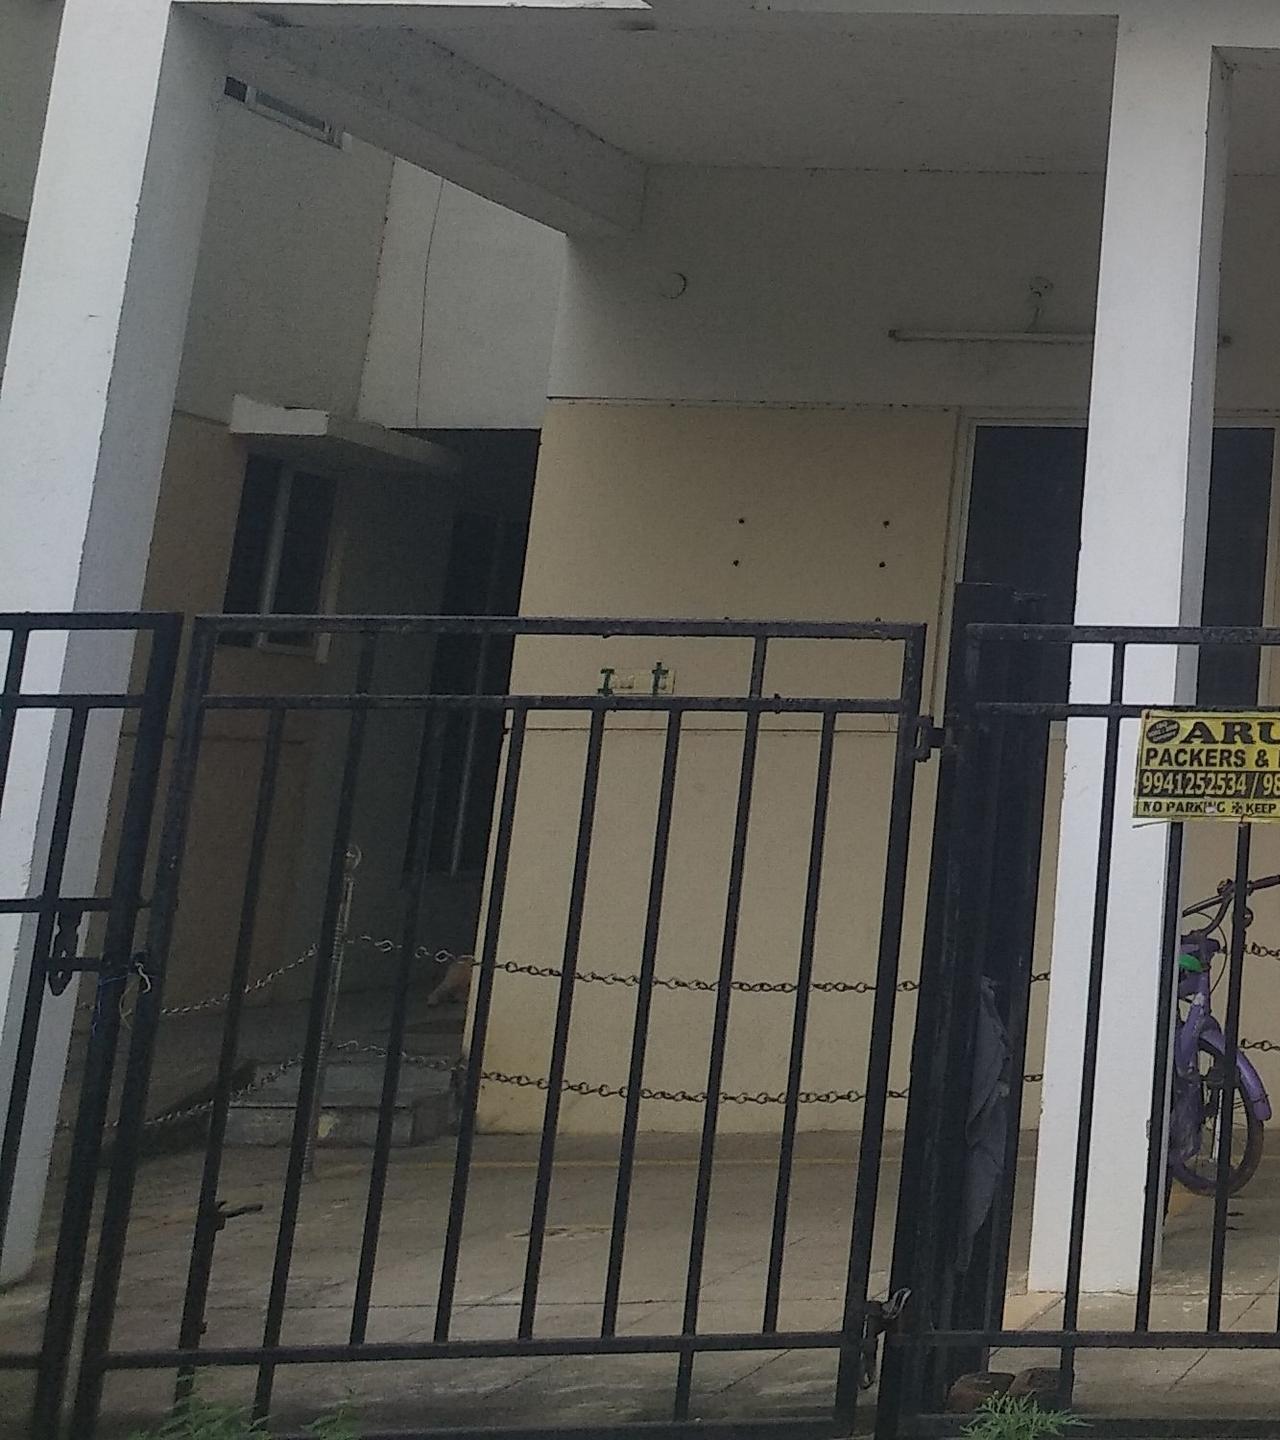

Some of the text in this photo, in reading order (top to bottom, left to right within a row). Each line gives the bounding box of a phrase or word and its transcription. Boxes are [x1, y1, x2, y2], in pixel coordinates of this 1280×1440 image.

[1145, 748, 1246, 768] PACKERS
[1255, 749, 1269, 768] &
[1142, 771, 1247, 795] 9941252534
[1143, 801, 1162, 813] NO
[1246, 803, 1277, 814] KEEP
